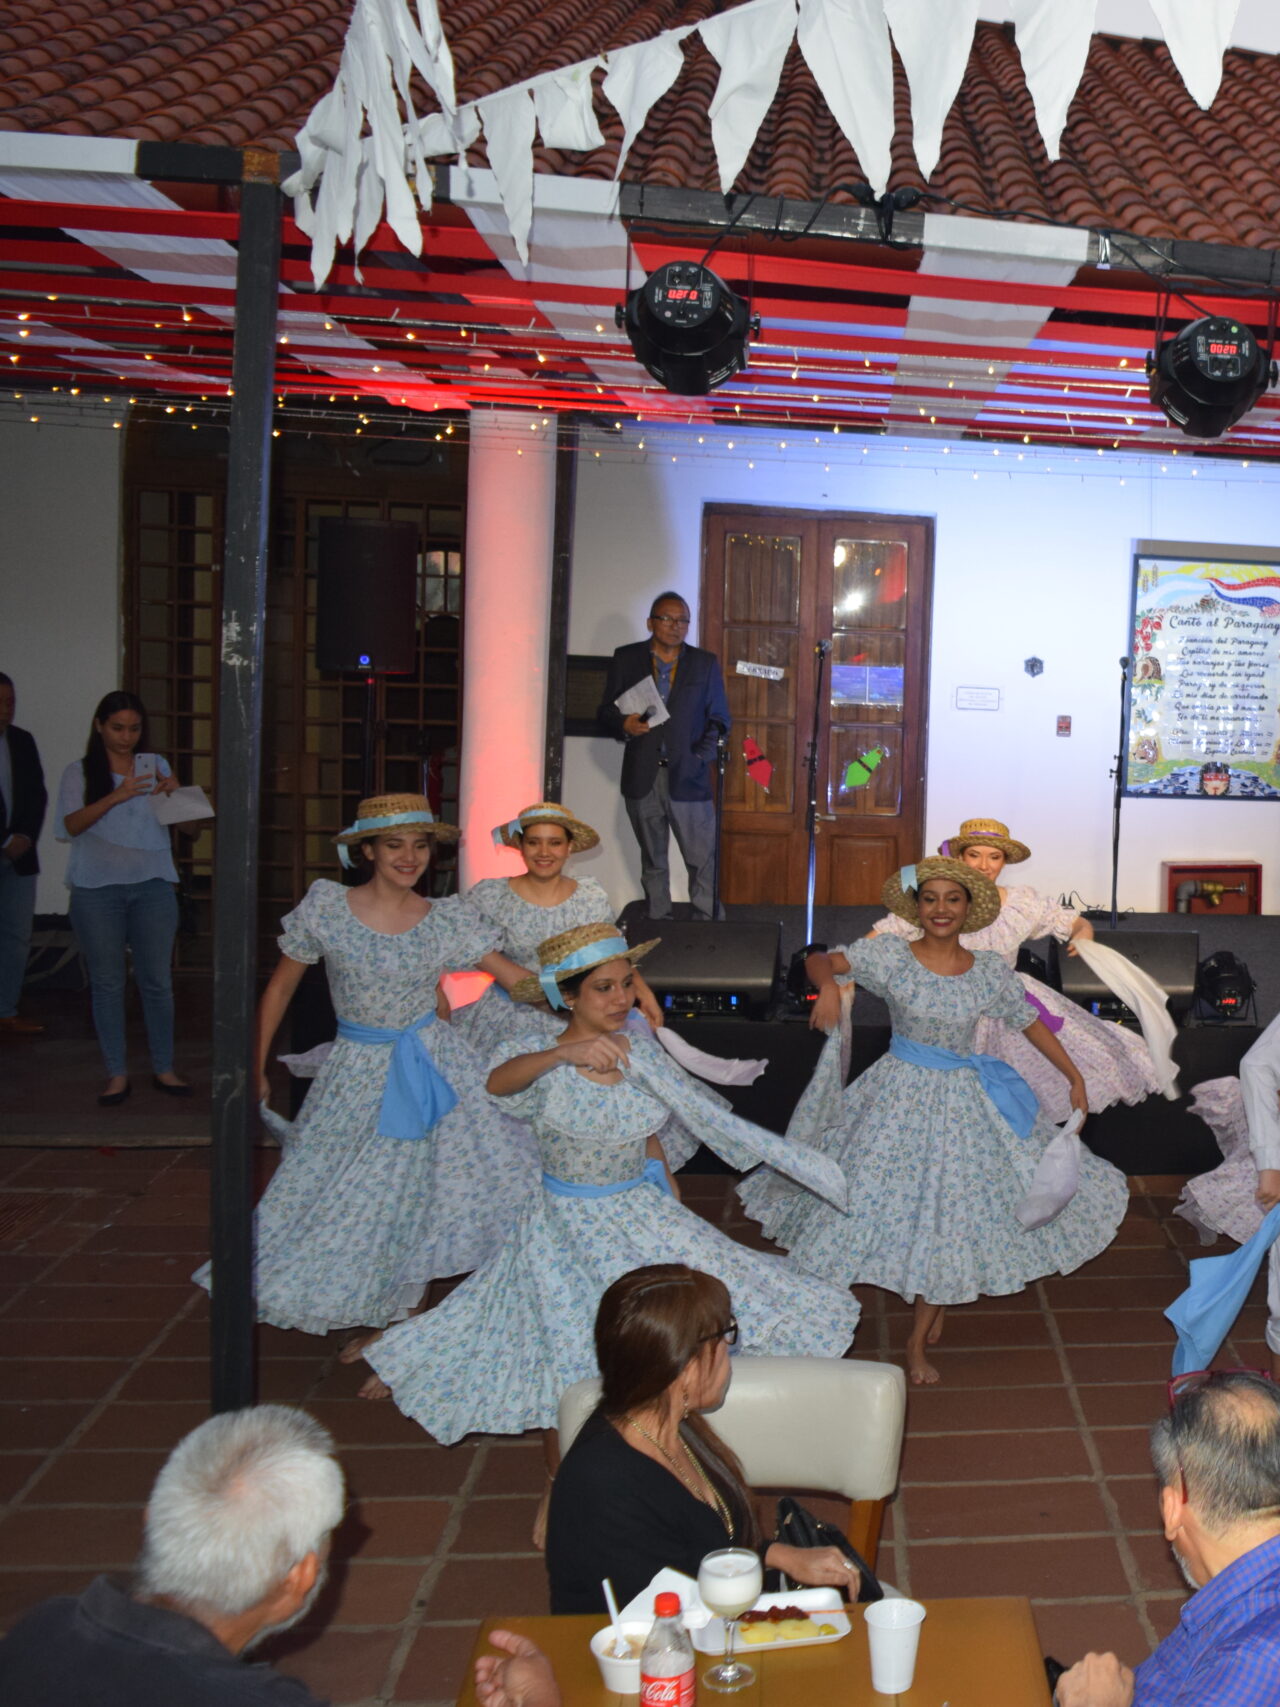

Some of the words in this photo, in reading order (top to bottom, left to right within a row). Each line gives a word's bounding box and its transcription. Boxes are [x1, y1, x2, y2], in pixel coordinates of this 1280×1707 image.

[1169, 615, 1202, 629] Canto
[1206, 617, 1219, 627] al
[1224, 617, 1280, 636] Paraguay
[1216, 636, 1228, 645] del
[1231, 637, 1269, 650] Paraguay
[1227, 661, 1232, 670] y
[1244, 671, 1265, 681] igual
[1175, 701, 1189, 711] Que
[646, 1680, 680, 1701] Cola
